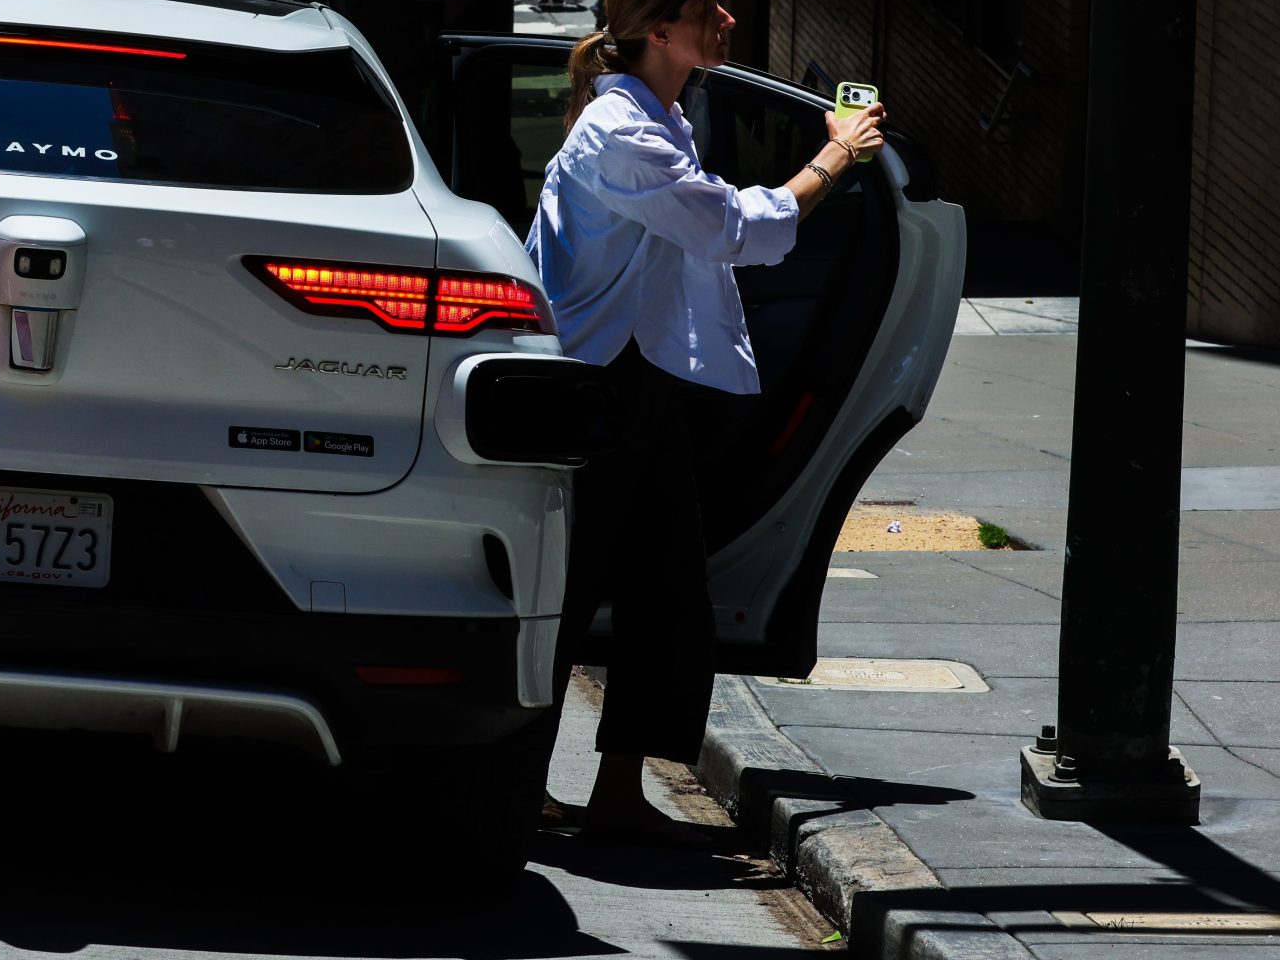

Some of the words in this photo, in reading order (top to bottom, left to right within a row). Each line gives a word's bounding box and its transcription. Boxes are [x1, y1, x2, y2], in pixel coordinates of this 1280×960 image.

[274, 357, 408, 380] JAGUAR
[250, 436, 268, 447] App
[269, 437, 293, 448] Store
[324, 440, 353, 452] Google
[353, 443, 370, 454] Play
